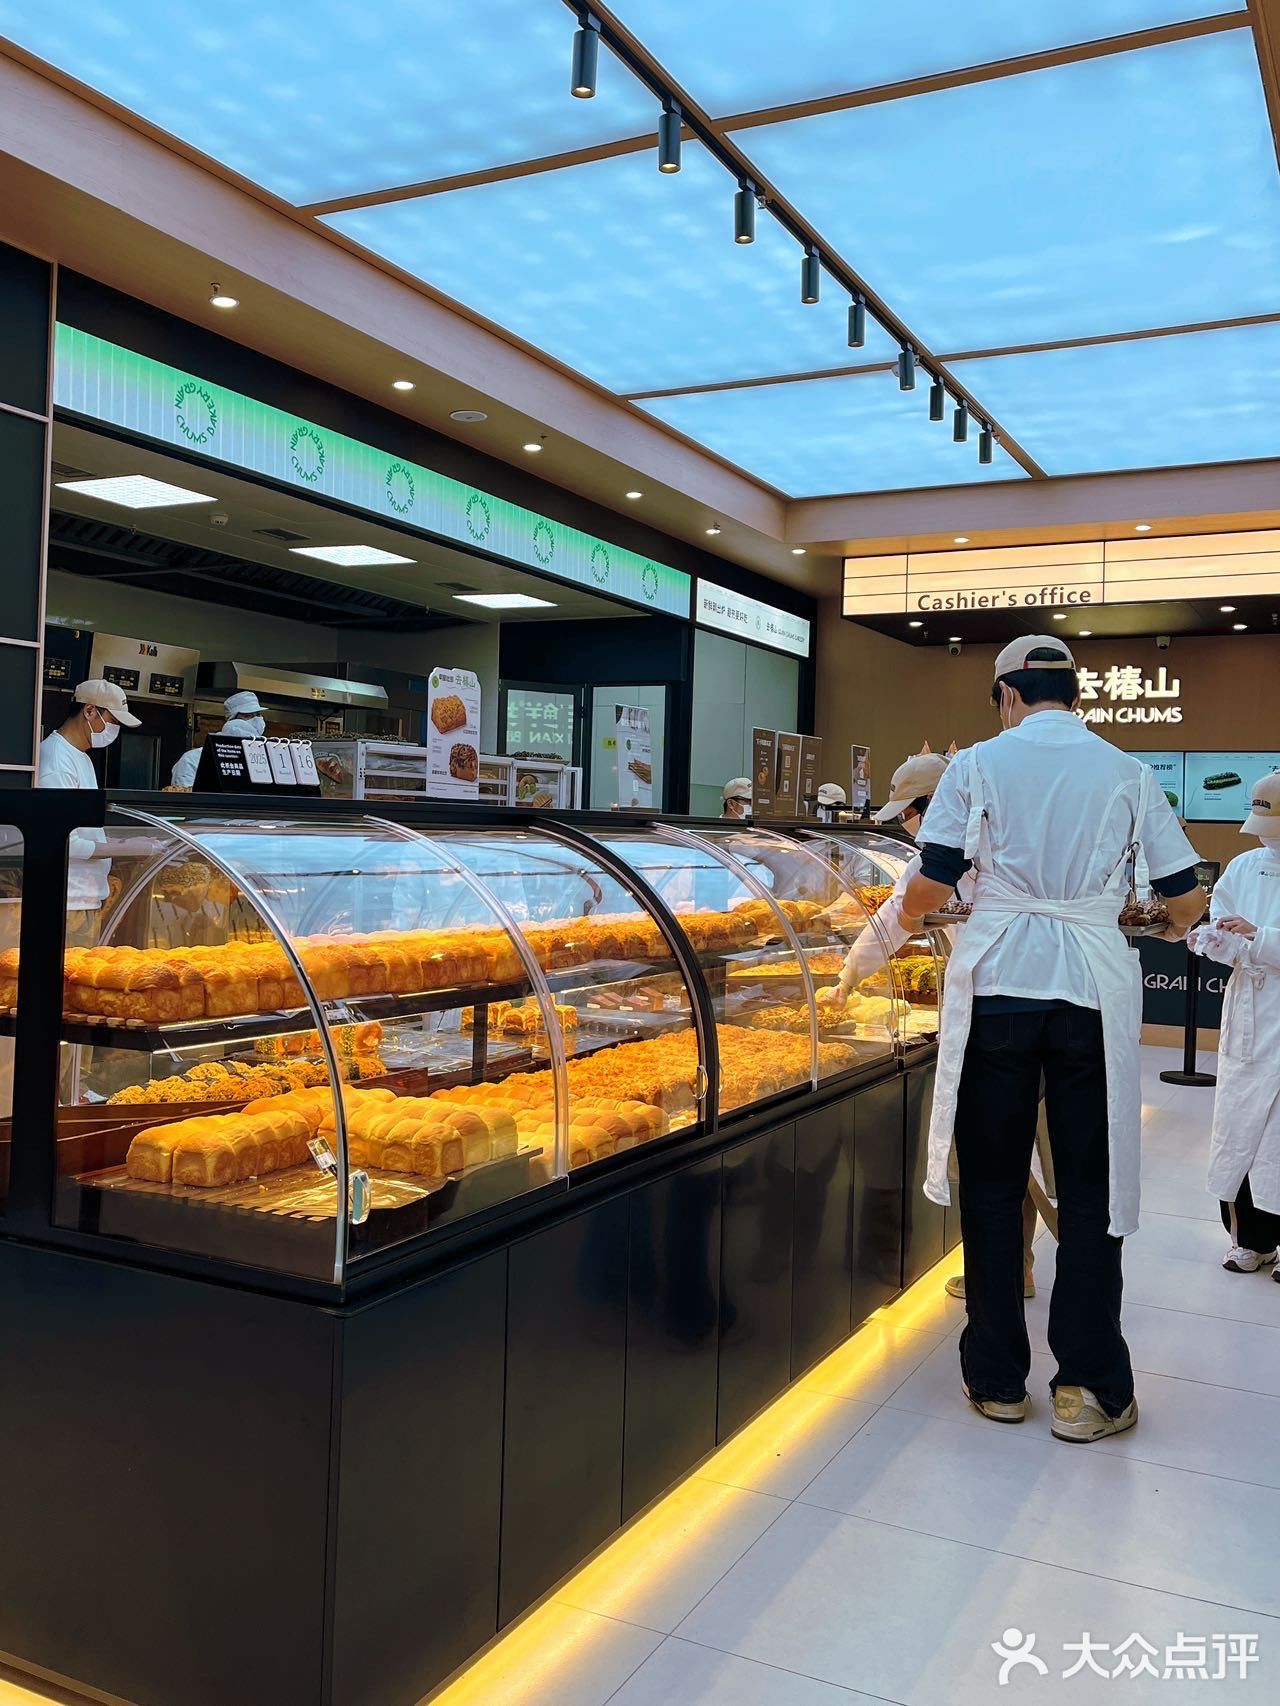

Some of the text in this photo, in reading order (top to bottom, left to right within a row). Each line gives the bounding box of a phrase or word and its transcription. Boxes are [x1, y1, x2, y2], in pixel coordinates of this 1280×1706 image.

[174, 382, 217, 444] GRAIN CHUMS BAKERY
[289, 426, 325, 483] GRAIN CHUMS BAKERY
[386, 462, 401, 486] GRAIN
[386, 490, 409, 514] CHUMS
[917, 586, 1092, 611] Cashier's office
[1076, 665, 1180, 701] 去椿山
[1072, 706, 1183, 724] RAIN CHUMS
[249, 752, 313, 769] 2025 1 16
[1206, 977, 1228, 993] CH
